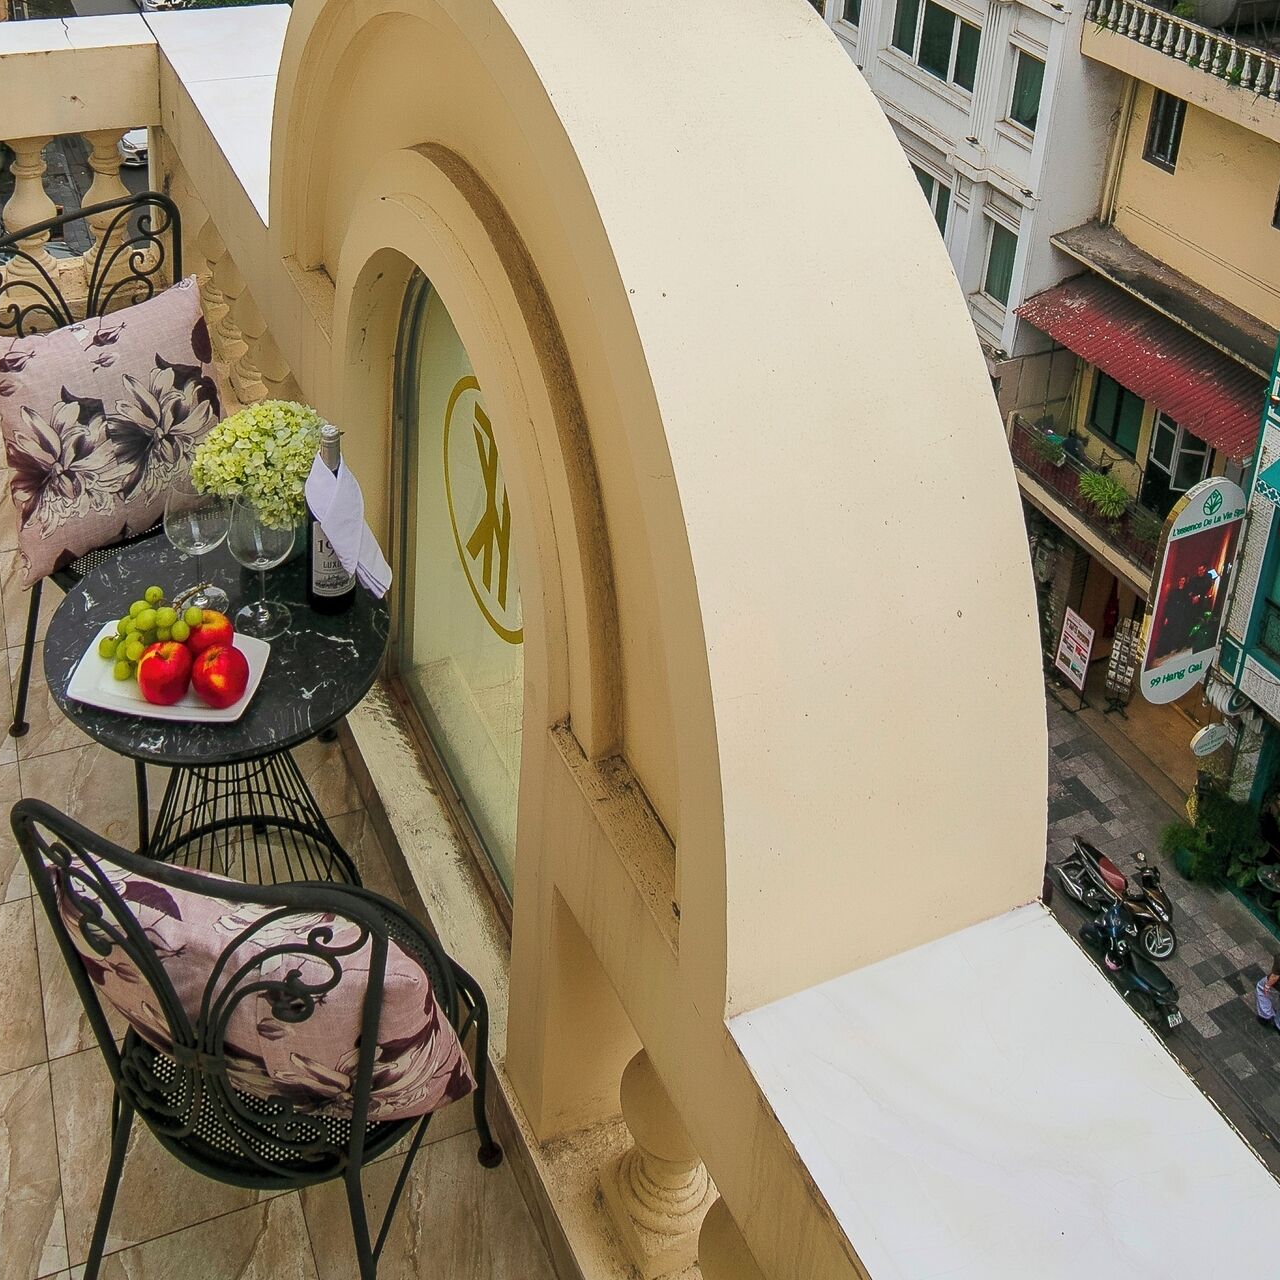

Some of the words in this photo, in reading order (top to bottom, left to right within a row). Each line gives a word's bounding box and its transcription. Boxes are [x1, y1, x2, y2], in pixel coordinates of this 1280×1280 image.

[1203, 518, 1213, 527] De
[1150, 676, 1161, 688] 99
[1162, 668, 1186, 684] Hang
[1187, 660, 1203, 674] Gai
